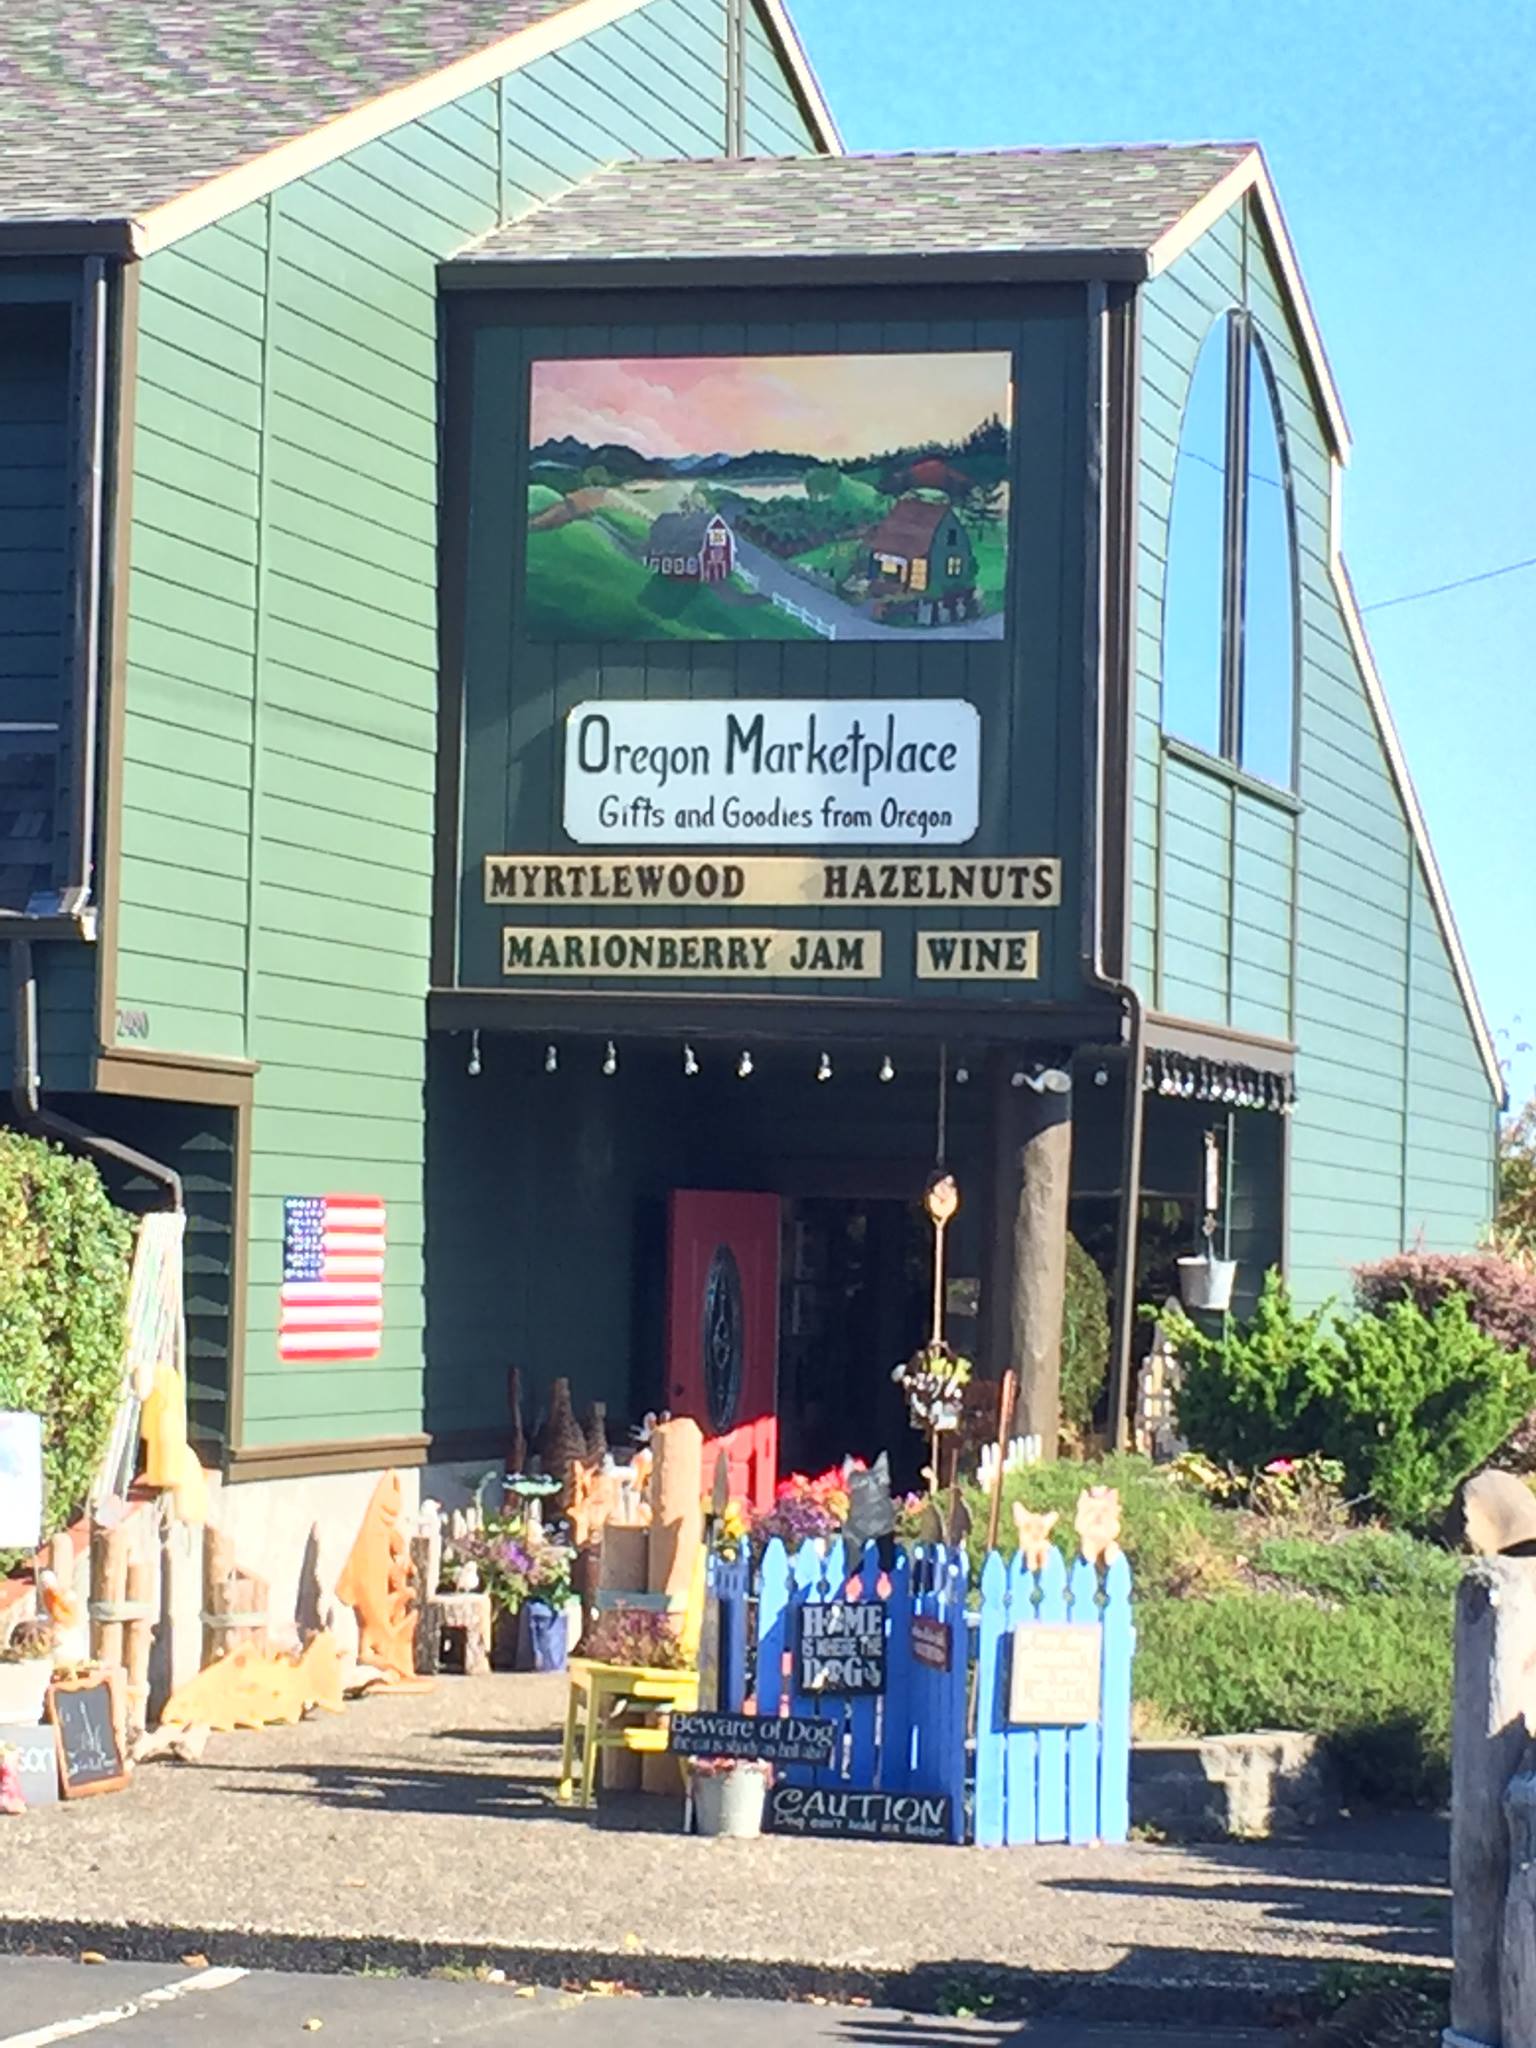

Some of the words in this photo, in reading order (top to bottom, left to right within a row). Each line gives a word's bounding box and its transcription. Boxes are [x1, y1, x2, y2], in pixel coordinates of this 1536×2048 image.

[578, 713, 710, 788] Oregon
[725, 712, 958, 787] Marketplace
[599, 794, 666, 828] Gifts
[674, 794, 715, 829] and
[722, 795, 814, 829] Goodies
[821, 795, 873, 828] from
[880, 796, 953, 839] Oregon
[489, 863, 746, 899] MYRTLEWOOD
[823, 864, 1054, 900] HAZELNUTS
[507, 934, 773, 970] MARIONBERRY
[790, 937, 865, 970] JAM
[926, 937, 1028, 972] WINE
[801, 1604, 883, 1637] HOME
[671, 1712, 753, 1737] Beware
[759, 1721, 781, 1740] of
[787, 1719, 833, 1748] Dog
[772, 1788, 947, 1825] CAUTION
